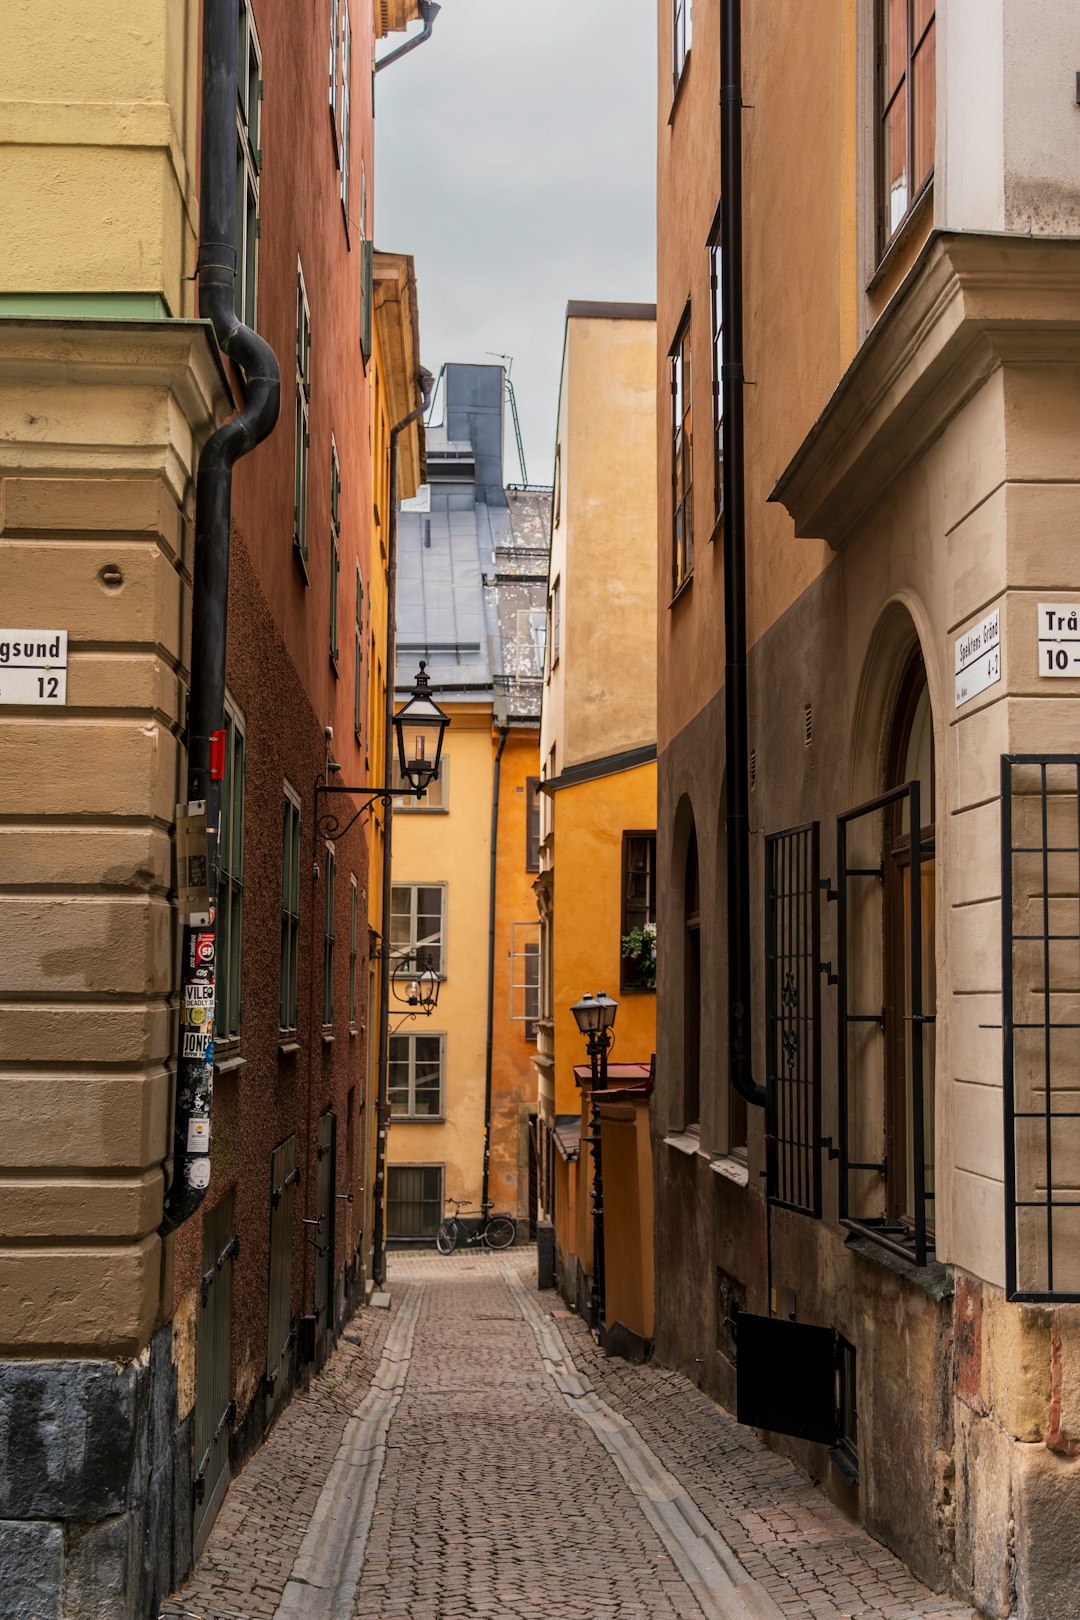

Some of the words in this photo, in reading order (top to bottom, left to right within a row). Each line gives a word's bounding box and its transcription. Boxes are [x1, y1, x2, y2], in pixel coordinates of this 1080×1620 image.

[1045, 611, 1078, 631] Trå
[0, 635, 60, 663] gsund
[960, 635, 981, 666] Spektens
[983, 614, 998, 643] Gränd
[988, 654, 998, 678] 4-2
[37, 677, 59, 698] 12
[186, 999, 208, 1007] DEADLY
